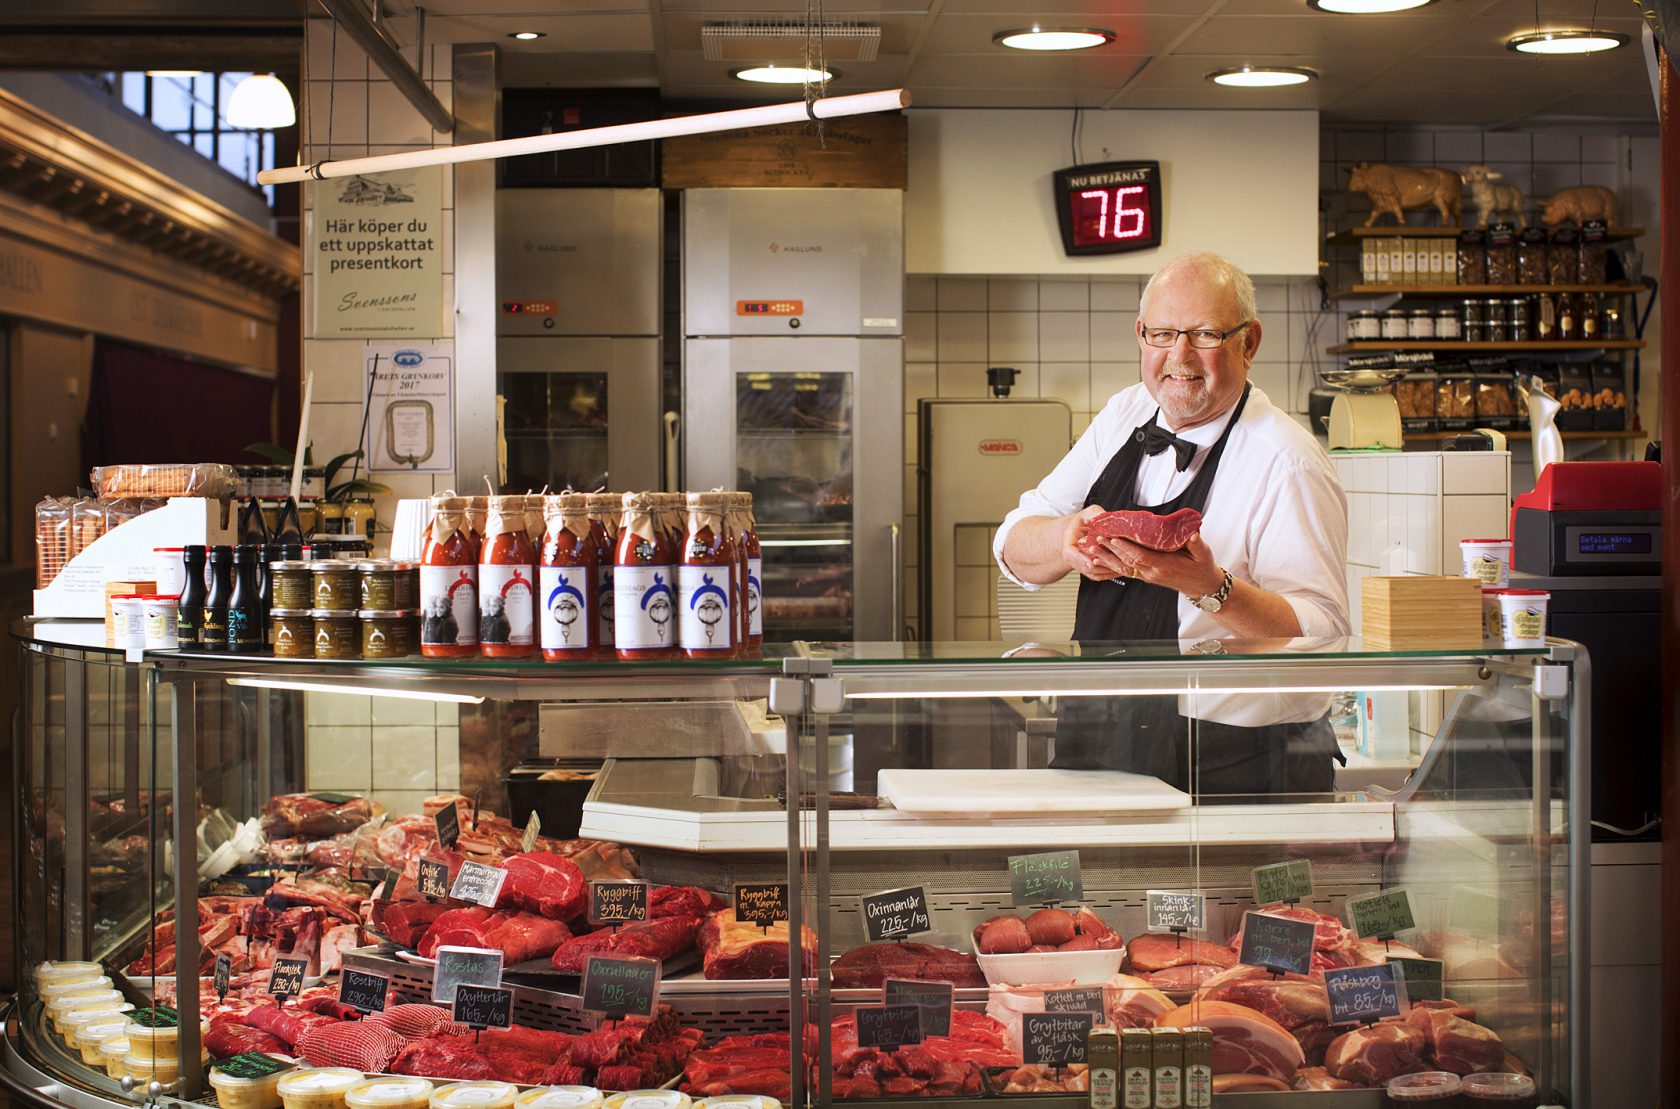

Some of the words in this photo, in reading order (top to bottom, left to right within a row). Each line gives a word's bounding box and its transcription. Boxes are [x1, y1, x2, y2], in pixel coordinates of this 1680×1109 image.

[1071, 177, 1088, 188] NU
[1090, 171, 1146, 185] BETJÄNAS
[1081, 186, 1145, 238] 76
[326, 219, 354, 233] Här
[358, 219, 403, 236] köper
[407, 218, 427, 233] du
[319, 239, 342, 252] ett
[346, 237, 434, 255] uppskattat
[330, 256, 423, 274] presentkort
[337, 291, 417, 312] Svenssons
[400, 381, 420, 390] 2017
[228, 609, 236, 644] FOND
[597, 885, 642, 902] Ryggbiff
[740, 886, 780, 903] Ryggbiff
[868, 895, 920, 919] Oxinnanlår
[591, 960, 655, 980] Oxrullader
[349, 973, 385, 993] Rostbiff
[458, 989, 509, 1008] Oxytterlår
[1045, 992, 1073, 1005] Kotlett
[1029, 1018, 1086, 1038] Grytbitar
